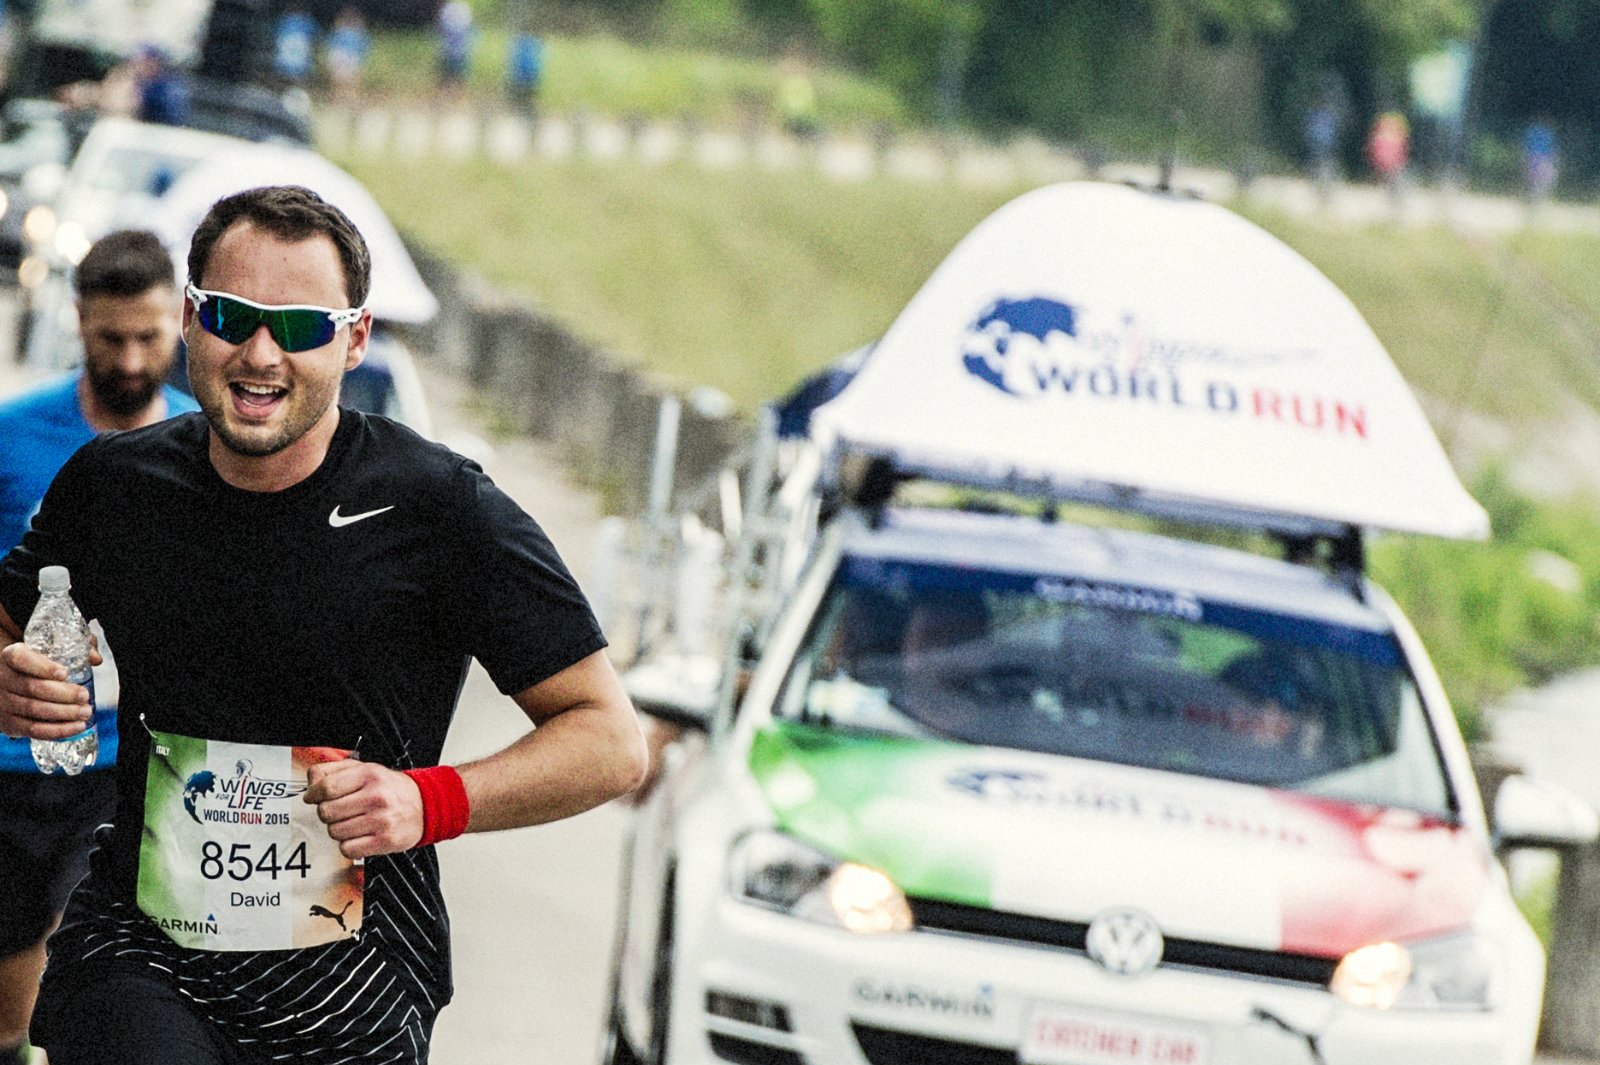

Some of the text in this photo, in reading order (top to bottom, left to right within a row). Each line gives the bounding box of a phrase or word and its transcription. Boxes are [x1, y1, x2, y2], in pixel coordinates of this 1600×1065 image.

[1030, 361, 1367, 439] WORLD RUN
[221, 776, 287, 797] WINGS
[228, 795, 267, 810] LIFE
[203, 809, 290, 825] WORLD RUN 2015
[200, 841, 312, 881] 8544
[230, 892, 281, 907] David
